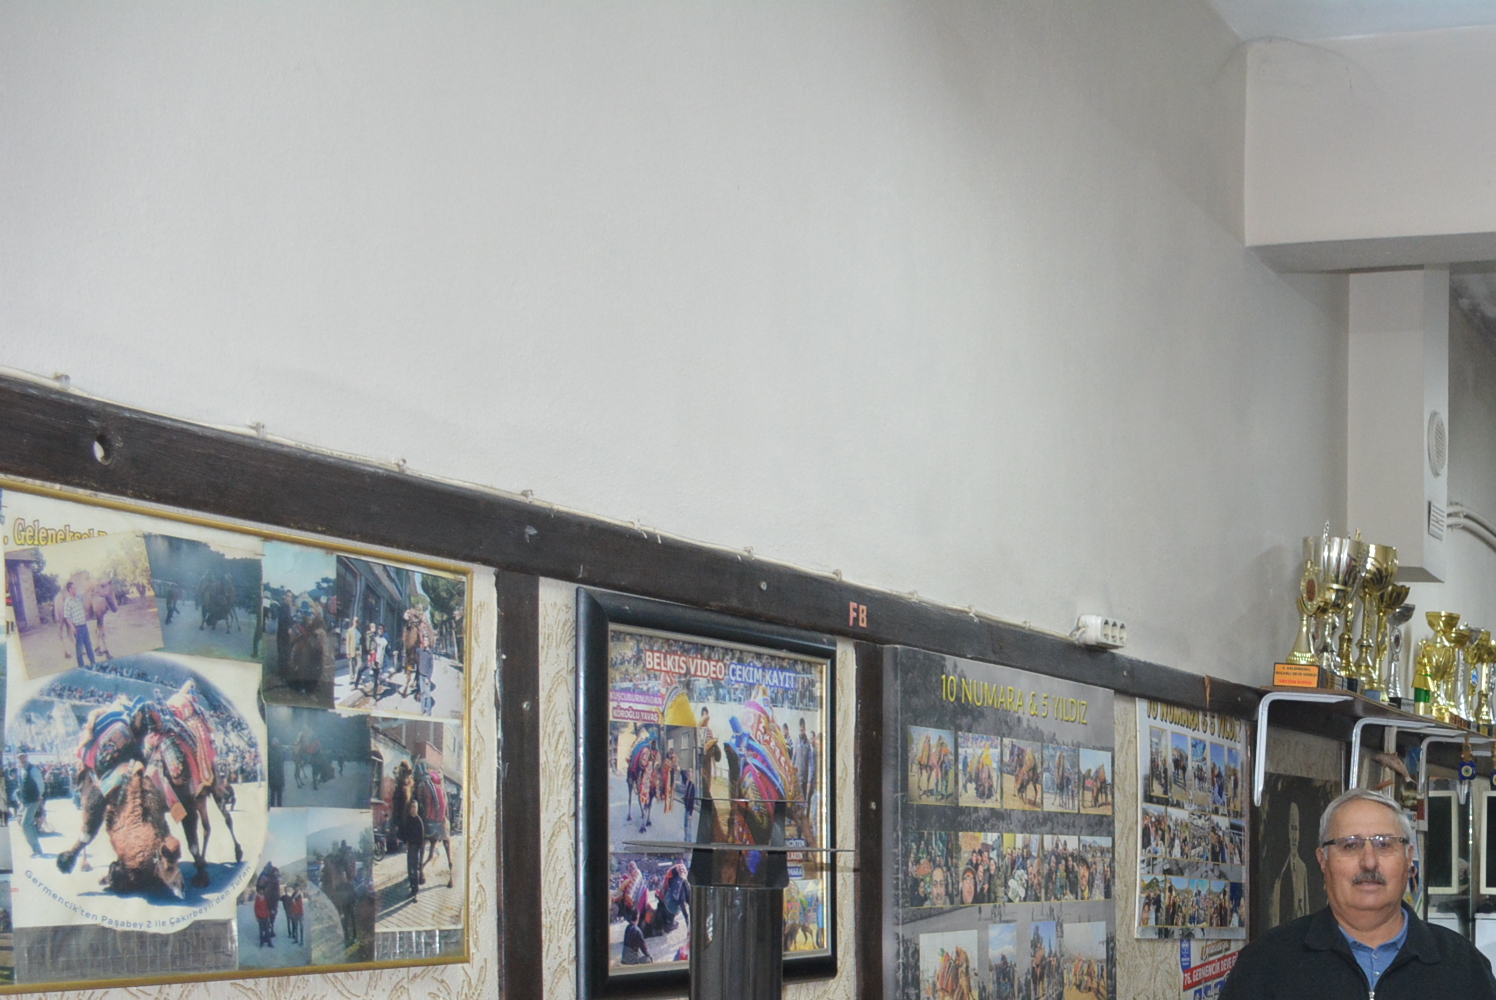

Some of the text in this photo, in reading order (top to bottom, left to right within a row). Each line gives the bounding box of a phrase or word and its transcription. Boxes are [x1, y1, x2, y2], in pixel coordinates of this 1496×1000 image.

[849, 601, 867, 628] FB
[689, 656, 725, 680] VİDEO
[729, 662, 763, 685] ÇEKİM
[765, 670, 796, 689] KAYIT
[941, 674, 1088, 725] 10 NUMARA & 5 YILDIZ
[25, 869, 98, 921] Germencik'ten
[101, 915, 144, 930] Paşabey
[147, 920, 152, 928] 2
[155, 919, 167, 927] ile
[1192, 959, 1221, 983] GERMENCİK
[1220, 958, 1232, 972] DEVE
